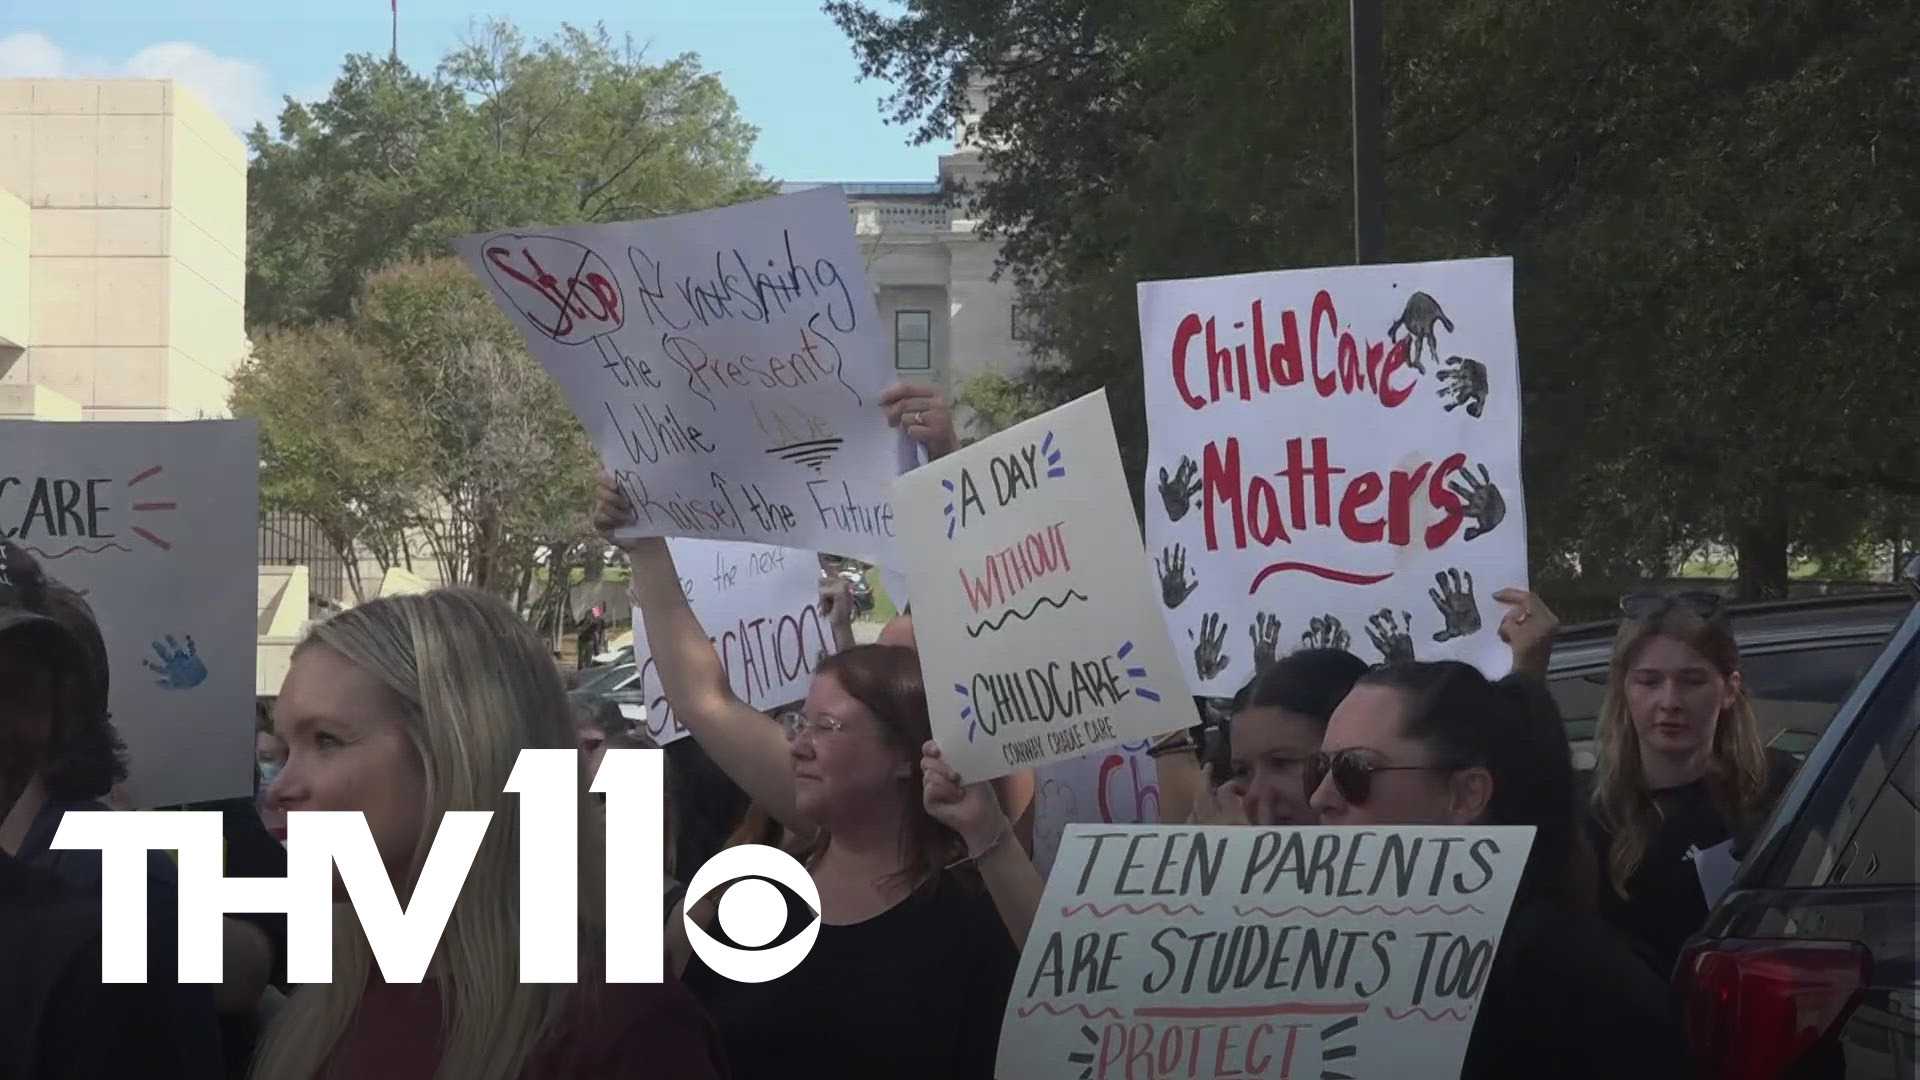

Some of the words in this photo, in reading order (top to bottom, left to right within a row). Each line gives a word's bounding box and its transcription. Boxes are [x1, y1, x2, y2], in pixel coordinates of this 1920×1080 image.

[604, 402, 716, 464] While
[741, 484, 797, 534] the
[806, 480, 897, 538] Future
[961, 468, 986, 527] A
[990, 444, 1040, 507] DAY
[1201, 436, 1468, 551] Matters
[713, 551, 737, 592] the
[748, 545, 785, 577] next
[959, 520, 1073, 614] WITHOUT
[971, 655, 1130, 736] CHILDCARE
[1084, 716, 1117, 744] CARE
[1073, 831, 1228, 898] TEEN
[1240, 830, 1501, 897] PARENTS
[1027, 930, 1128, 998] ARE
[1142, 924, 1397, 998] STUDENTS
[1412, 931, 1495, 1005] TOO
[1096, 1022, 1313, 1080] PROTECT
